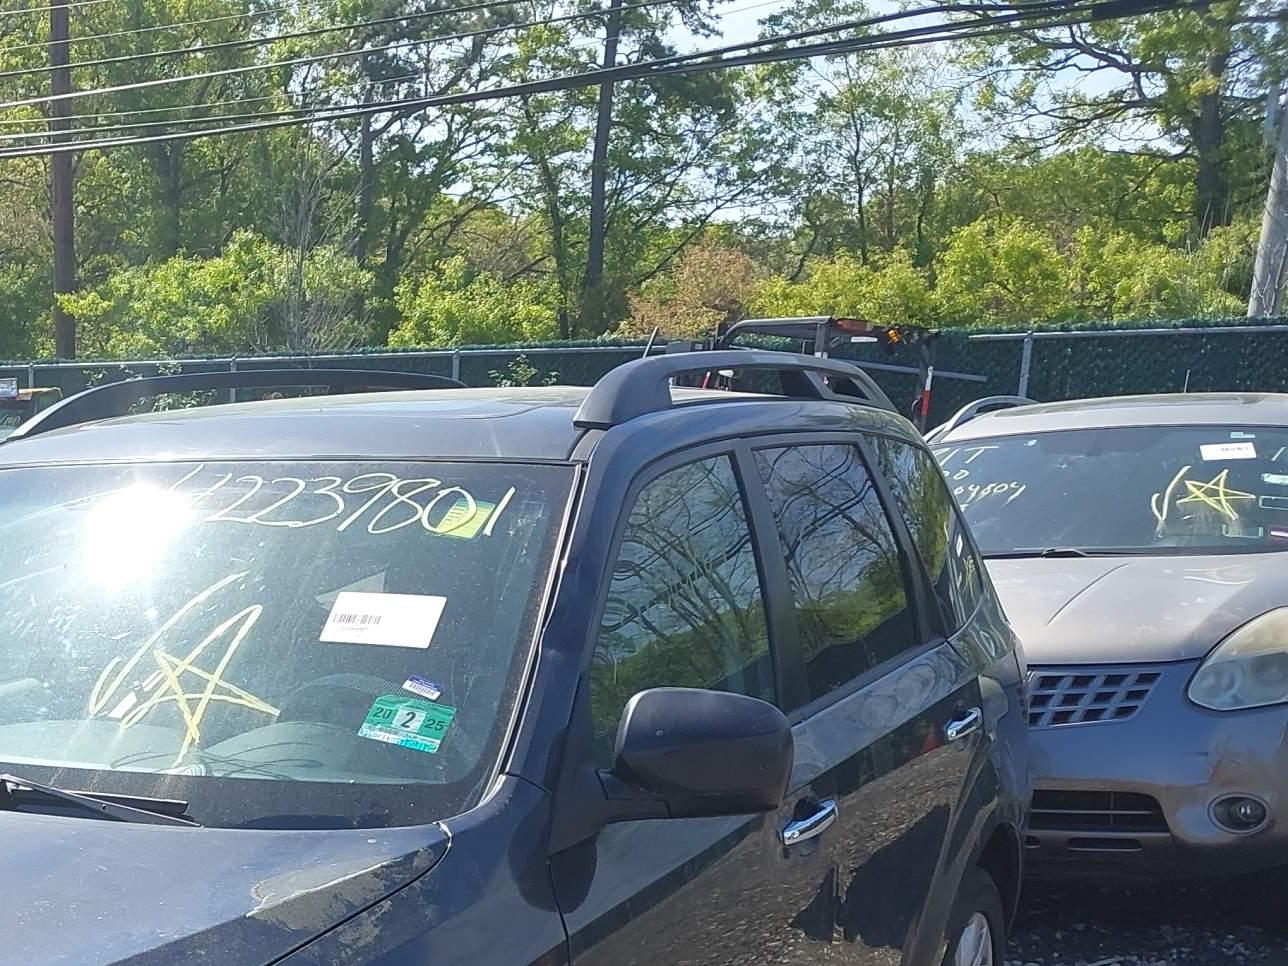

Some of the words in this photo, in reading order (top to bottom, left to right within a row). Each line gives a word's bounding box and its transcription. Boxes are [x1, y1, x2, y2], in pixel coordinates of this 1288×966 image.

[373, 706, 392, 720] 20
[400, 711, 417, 728] 2
[424, 718, 446, 732] 25
